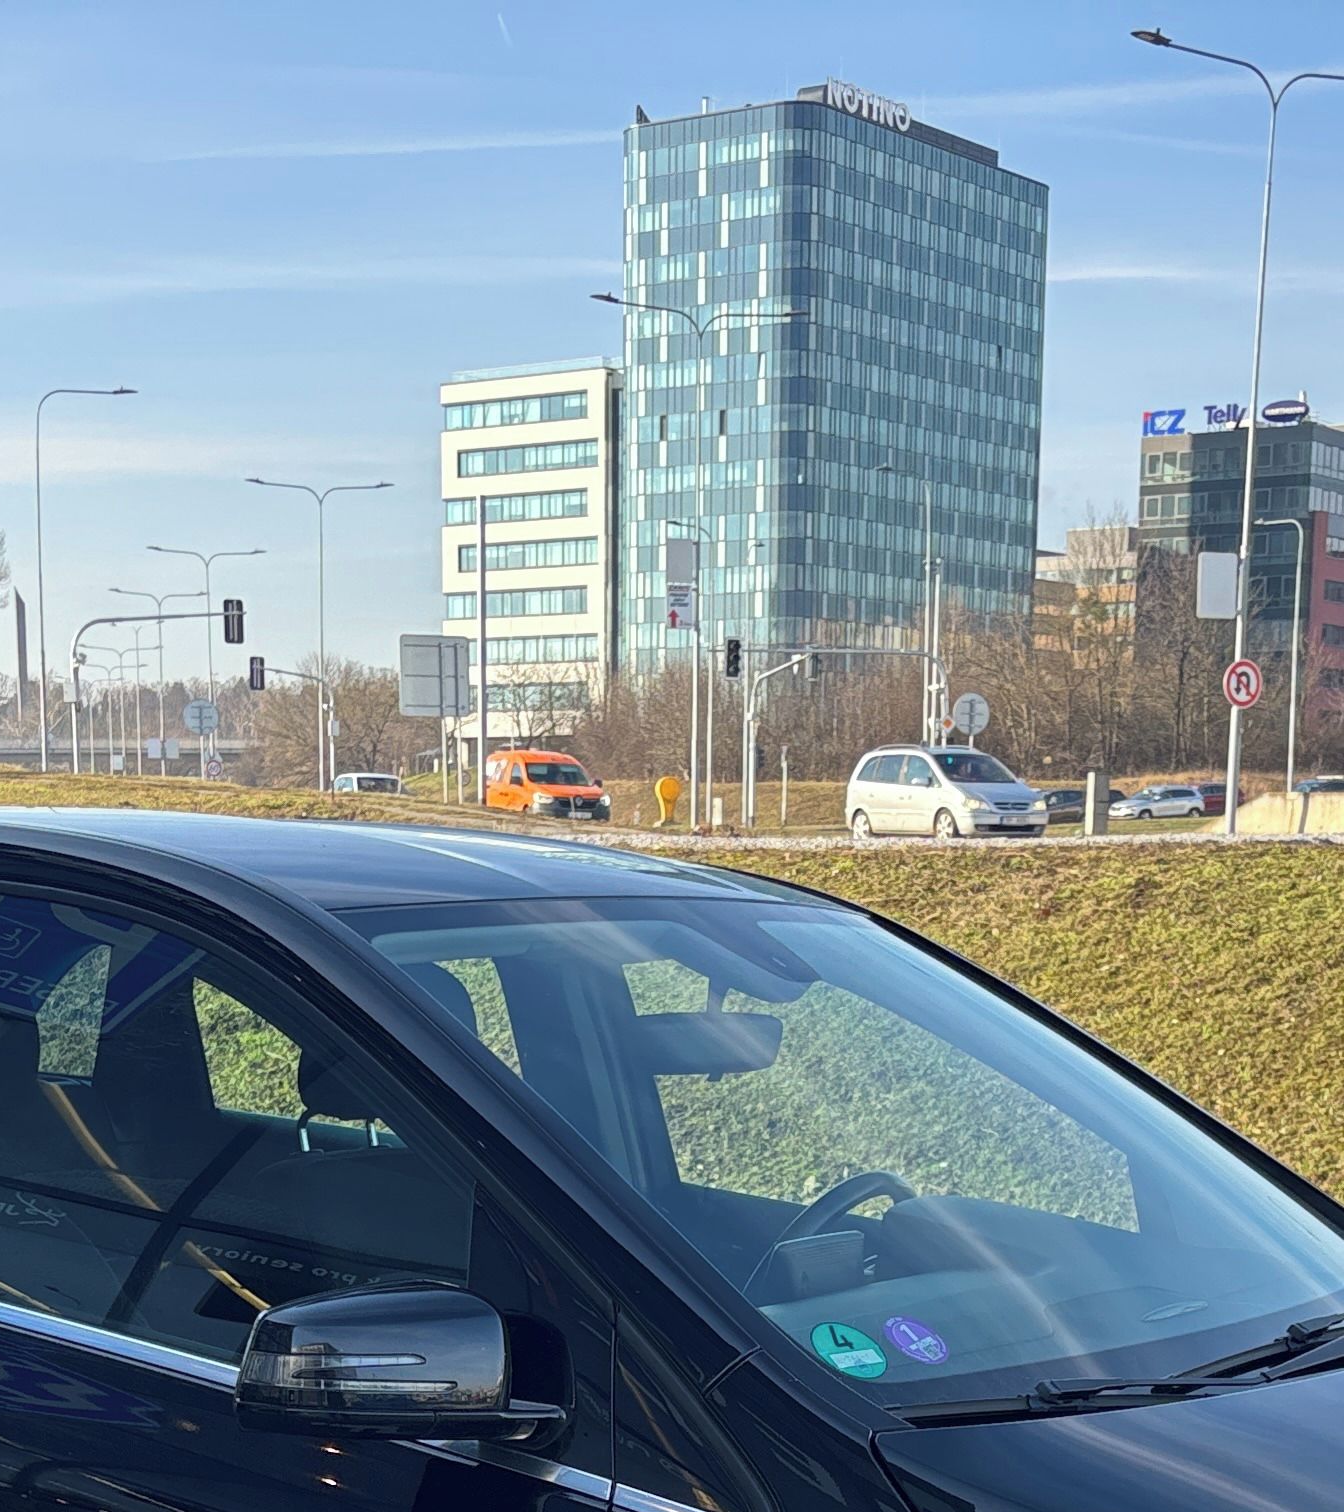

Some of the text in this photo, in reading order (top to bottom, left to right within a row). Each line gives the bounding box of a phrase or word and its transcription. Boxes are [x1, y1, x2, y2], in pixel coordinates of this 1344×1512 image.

[826, 76, 911, 132] NOTINO
[1143, 409, 1186, 436] ICZ
[1203, 404, 1248, 430] Telly
[828, 1325, 855, 1350] 4
